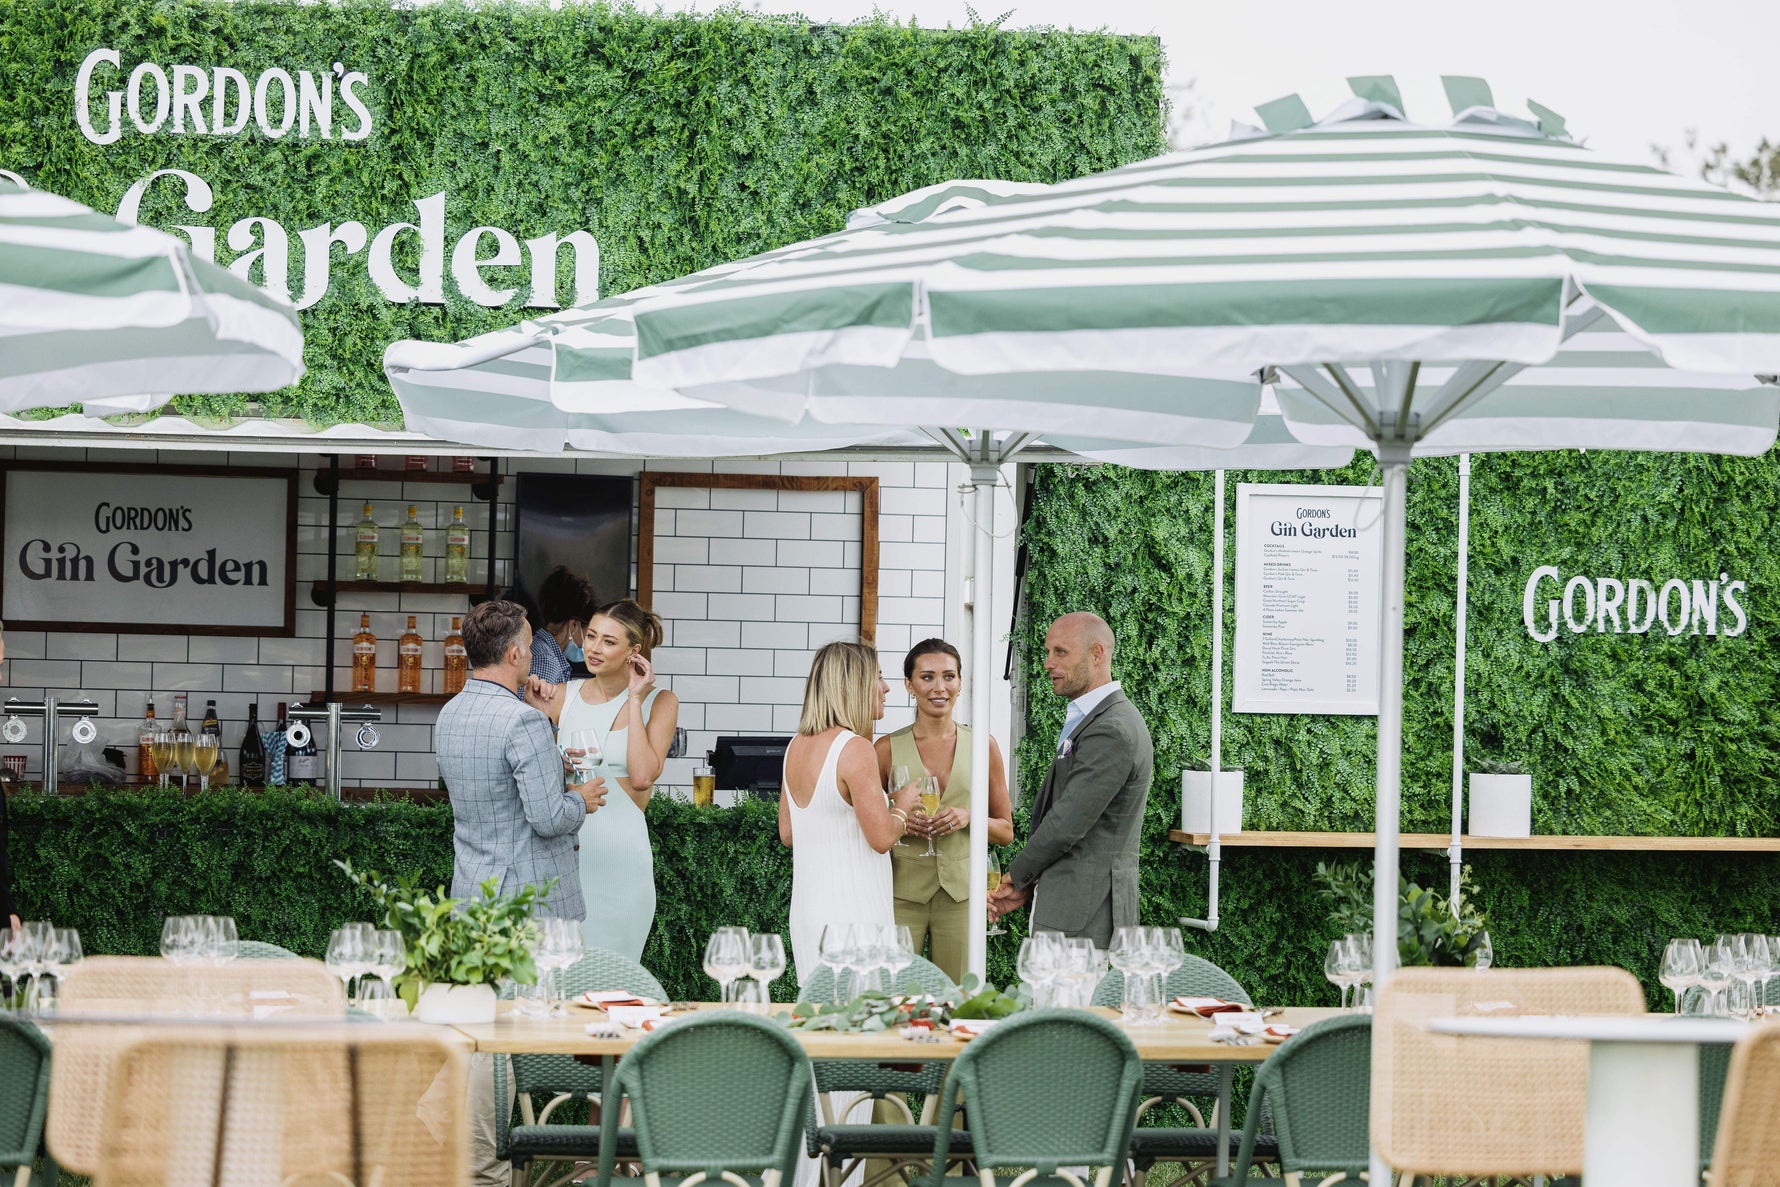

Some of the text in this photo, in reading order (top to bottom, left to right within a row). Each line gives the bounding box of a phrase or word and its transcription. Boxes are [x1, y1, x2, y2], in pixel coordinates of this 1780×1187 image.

[75, 48, 373, 145] GORDON'S
[94, 501, 193, 534] GORDON'S
[1271, 521, 1356, 539] Gin Garden
[1296, 507, 1331, 519] GORDON'S
[19, 539, 269, 588] Gin Garden
[1523, 565, 1748, 643] GORDON'S
